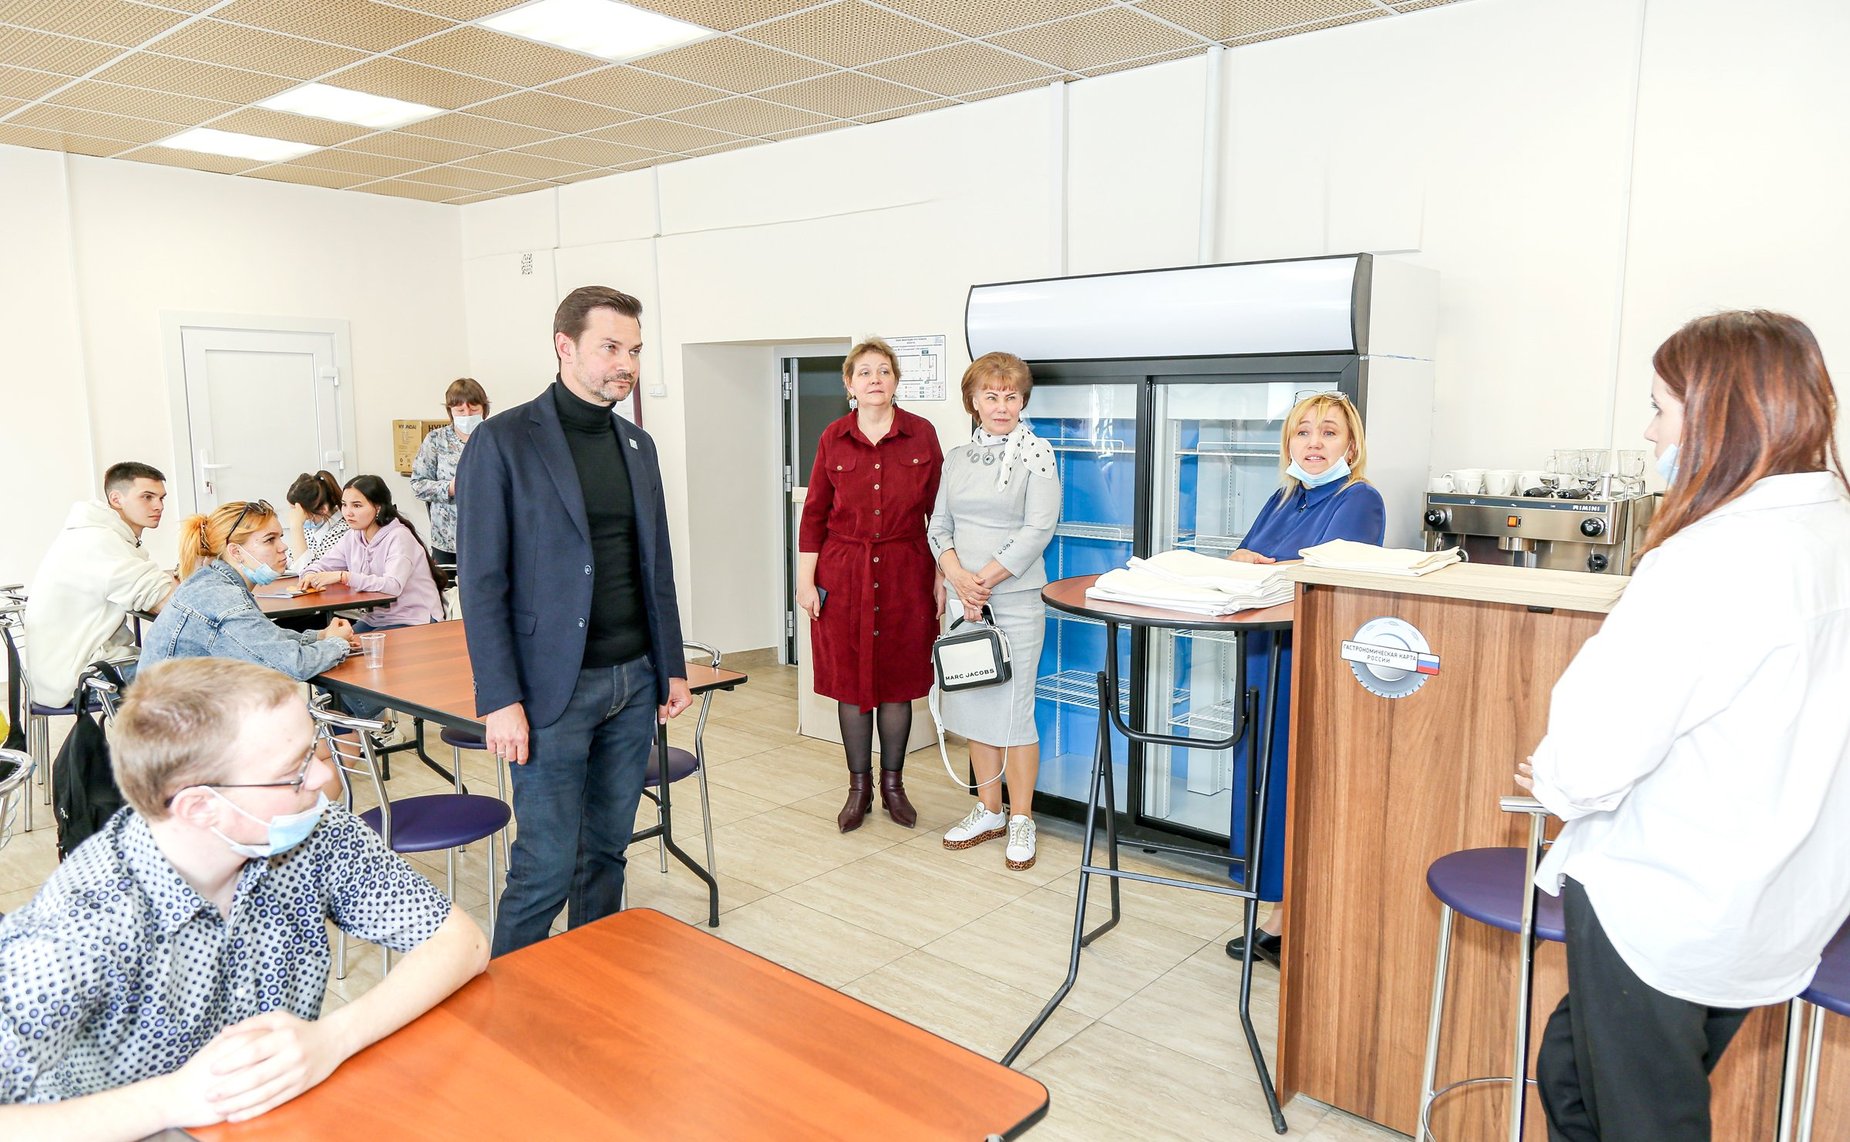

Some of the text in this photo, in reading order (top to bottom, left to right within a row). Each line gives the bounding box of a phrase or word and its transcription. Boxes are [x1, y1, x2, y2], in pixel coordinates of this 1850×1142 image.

[1343, 643, 1416, 661] ГАСТРОНОМИЧЕСКАЯ КАРТА
[1366, 654, 1391, 664] РОССИИ
[965, 668, 995, 678] JACOBS
